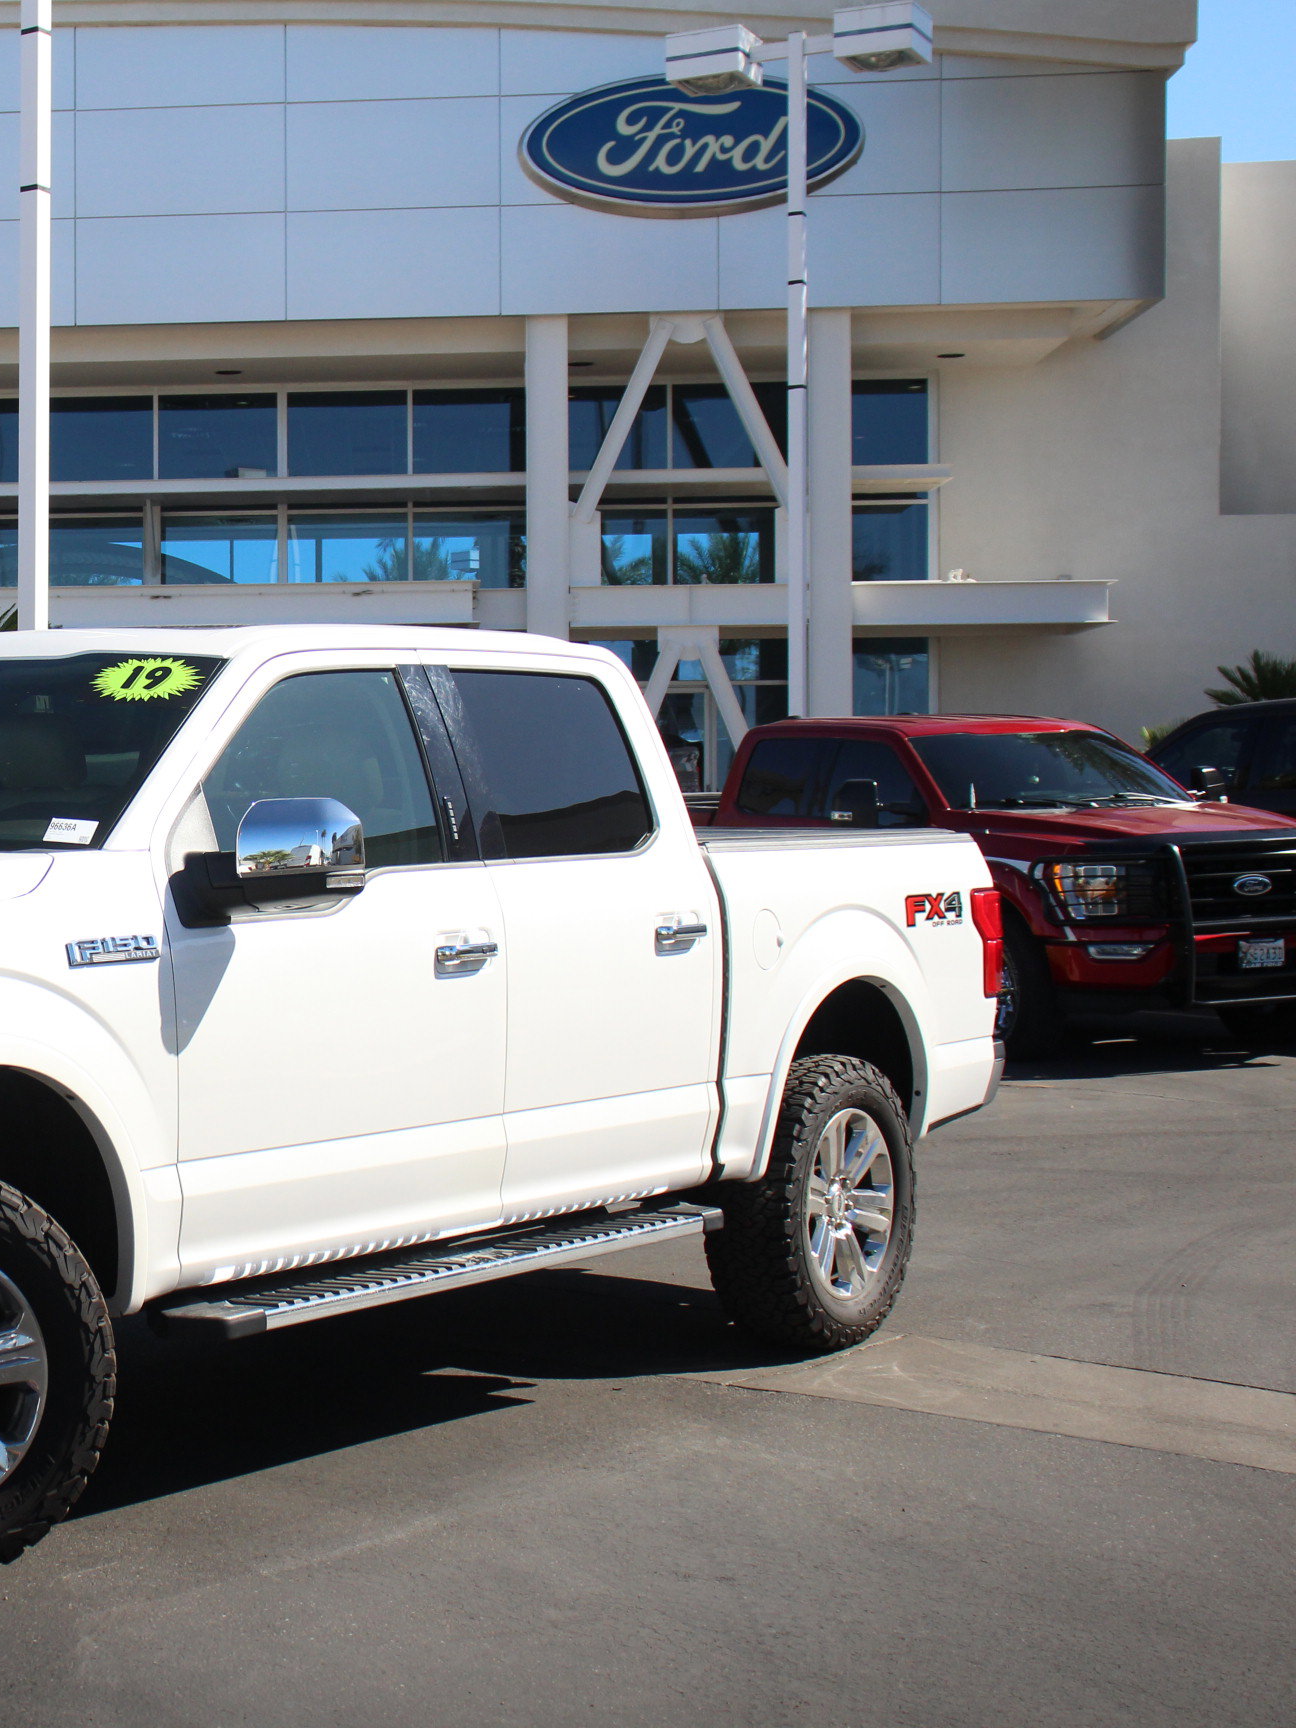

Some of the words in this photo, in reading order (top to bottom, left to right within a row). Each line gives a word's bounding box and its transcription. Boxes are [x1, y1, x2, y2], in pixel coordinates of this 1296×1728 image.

[597, 101, 789, 177] Ford
[120, 665, 173, 690] 19
[905, 891, 962, 927] FX4
[932, 920, 945, 928] OFF
[947, 918, 963, 926] ROAD
[125, 949, 157, 960] LARIAT
